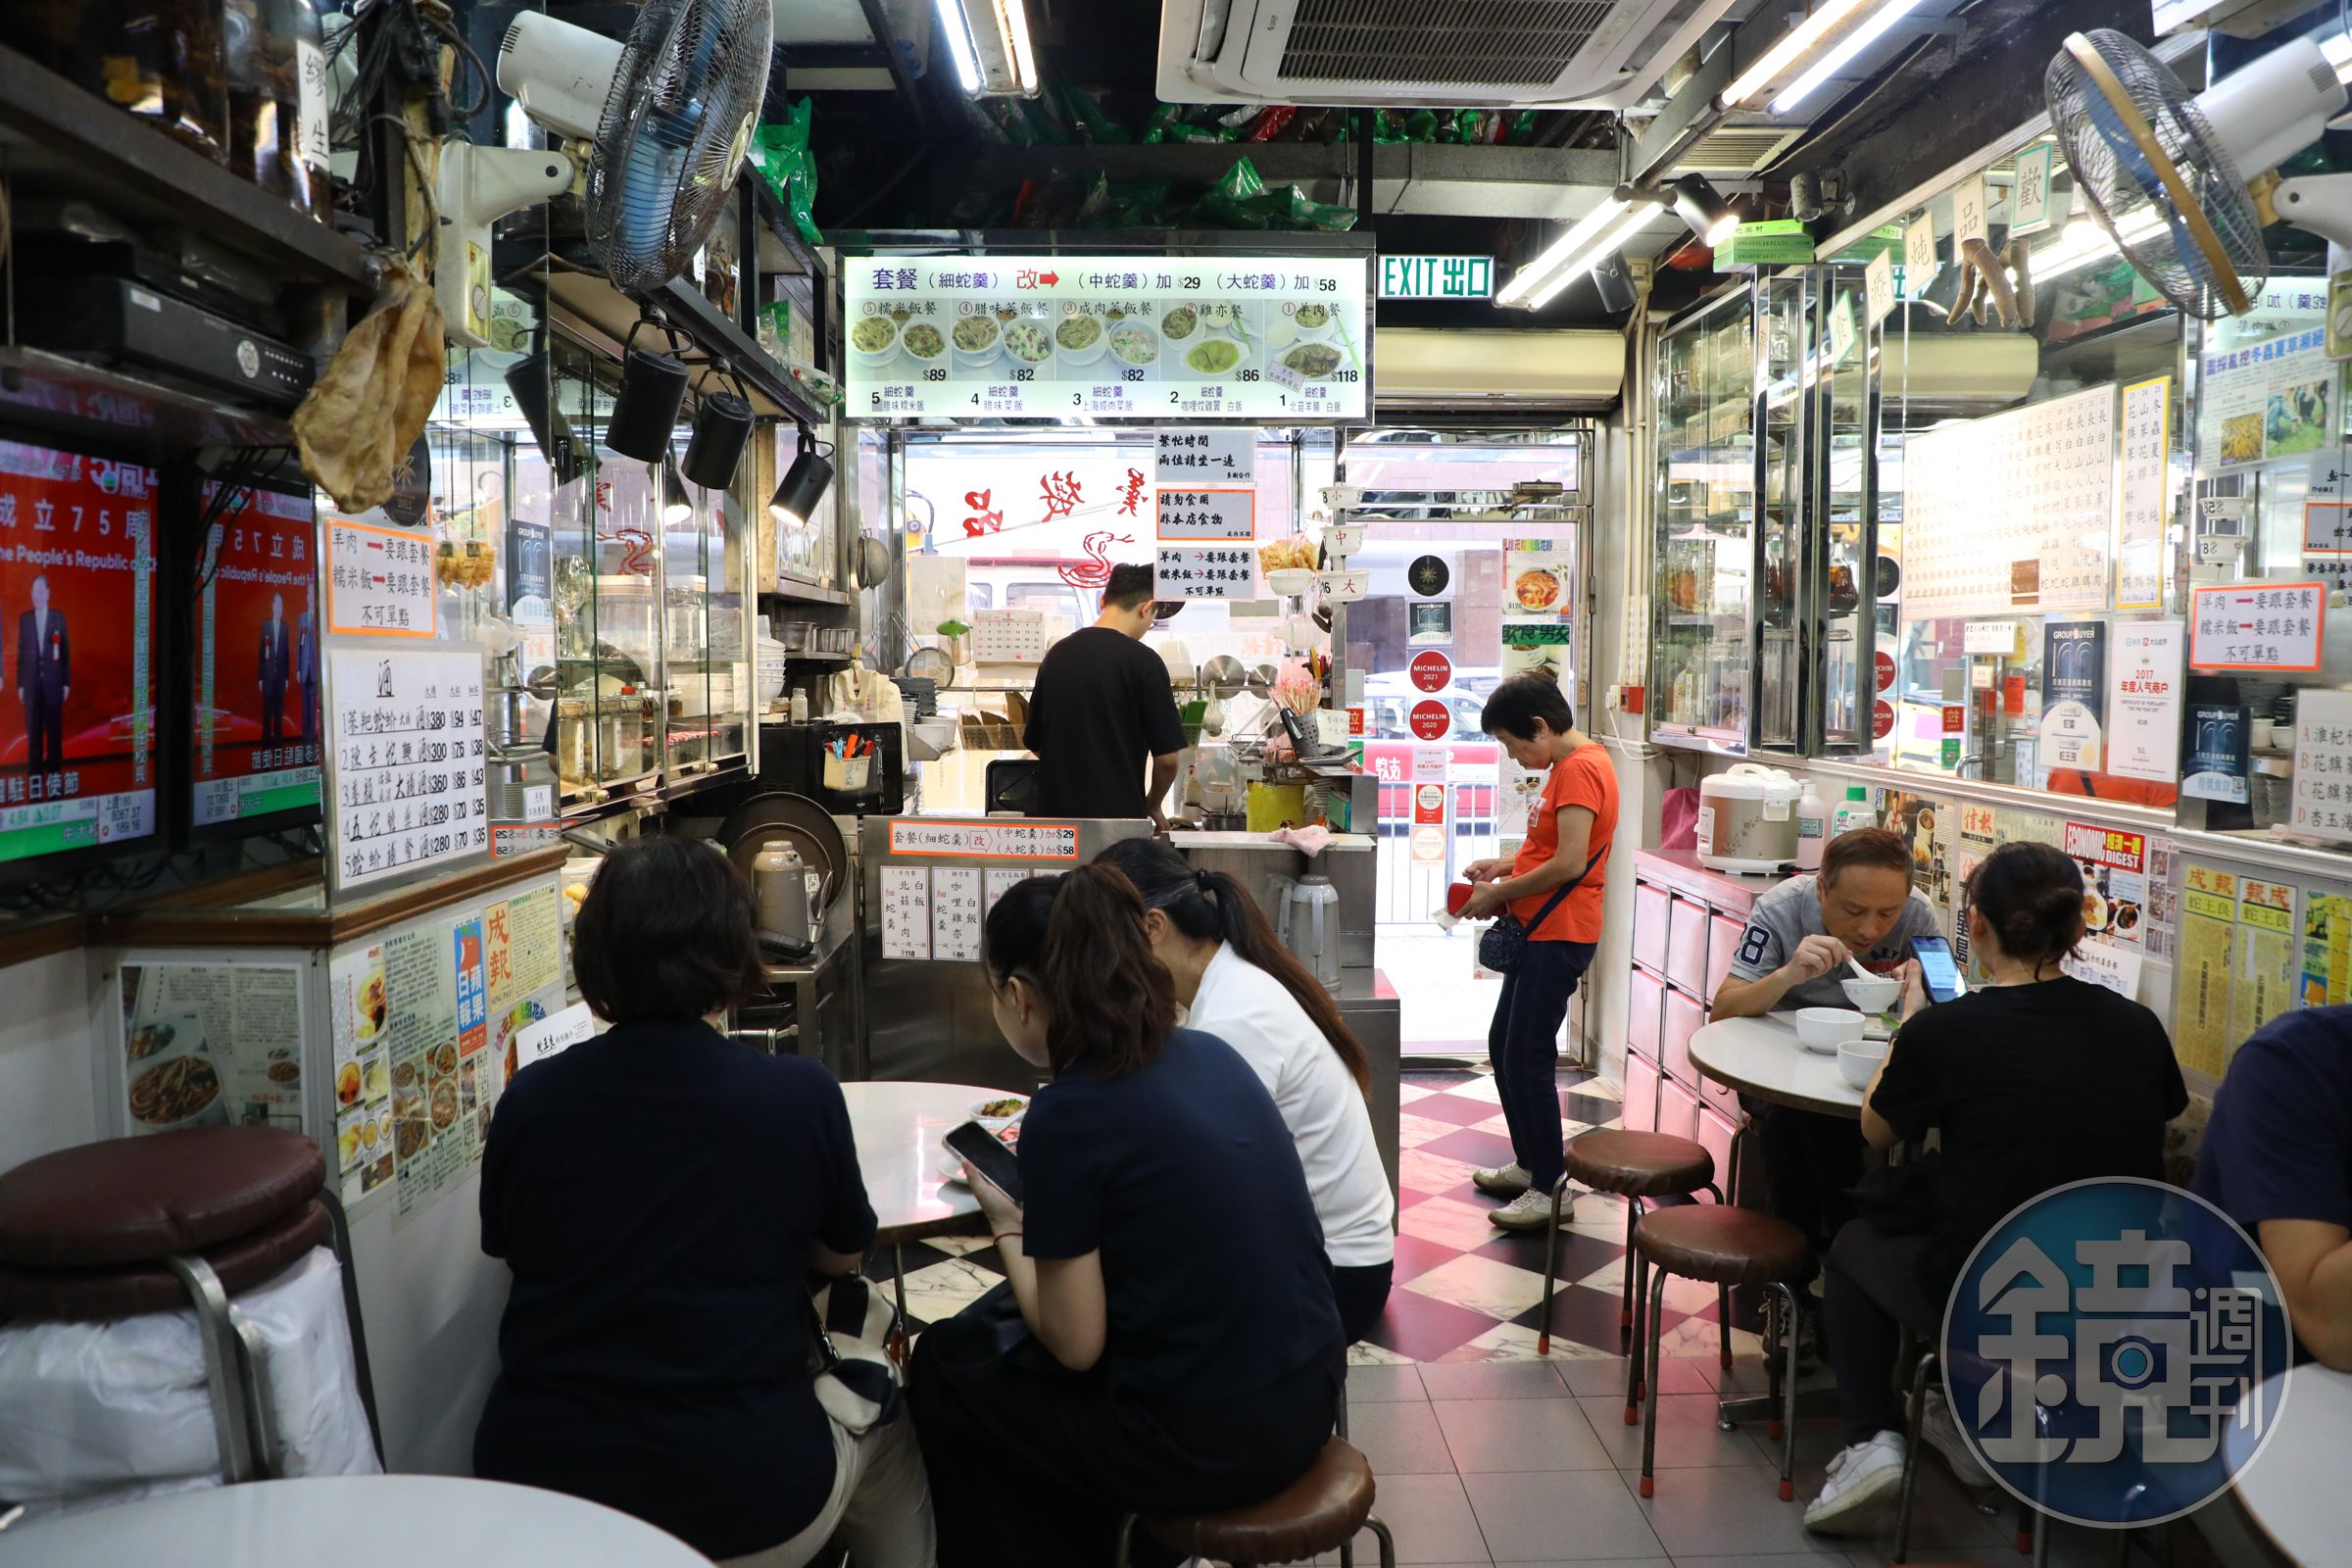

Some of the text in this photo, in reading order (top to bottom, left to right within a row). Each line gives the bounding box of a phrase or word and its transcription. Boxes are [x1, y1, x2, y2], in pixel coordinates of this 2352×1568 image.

[1960, 202, 1978, 238] 品
[872, 268, 917, 290] 套餐
[1016, 269, 1037, 290] 改
[1385, 258, 1489, 296] EXIT 出口
[922, 368, 946, 381] $89
[1009, 368, 1034, 381] $82
[1121, 369, 1145, 381] $82
[1235, 369, 1259, 381] $86
[1331, 370, 1358, 382] $118
[1158, 434, 1209, 448] 繁忙時間
[1159, 493, 1209, 507] 請勿食用
[1159, 513, 1223, 526] 非本店食物
[333, 528, 430, 565] 羊肉 要跟套餐
[1335, 530, 1347, 546] 中
[75, 551, 127, 571] Republic
[386, 571, 430, 598] 要跟套餐
[1342, 578, 1355, 594] 大
[2202, 590, 2312, 611] 羊肉 要跟套餐
[362, 605, 410, 626] 不可單點
[2254, 617, 2311, 637] 要跟套餐
[2225, 644, 2279, 662] 不可單點
[2135, 669, 2154, 680] 2017
[2121, 681, 2169, 694] 年度人气商户
[425, 711, 446, 729] $380
[450, 710, 464, 727] $94
[469, 710, 482, 725] $47
[427, 743, 447, 760] $300
[470, 739, 483, 756] $38
[1375, 757, 1400, 768] 的士
[428, 774, 448, 793] $360
[471, 768, 483, 785] $43
[1376, 768, 1401, 781] TAXI
[429, 805, 449, 822] $280
[454, 802, 466, 819] $70
[472, 799, 484, 815] $35
[1964, 809, 1993, 833] 信報
[429, 835, 450, 853] $280
[455, 832, 467, 851] $70
[473, 828, 485, 846] $35
[2067, 825, 2106, 862] ECONOMIC
[2106, 851, 2140, 868] DIGEST
[2188, 868, 2233, 896] 成報
[2188, 895, 2230, 917] 蛇王良
[2243, 906, 2290, 929] 蛇王良
[488, 909, 511, 988] 成報
[458, 970, 471, 1028] 日報
[470, 963, 486, 1021] 蘋果
